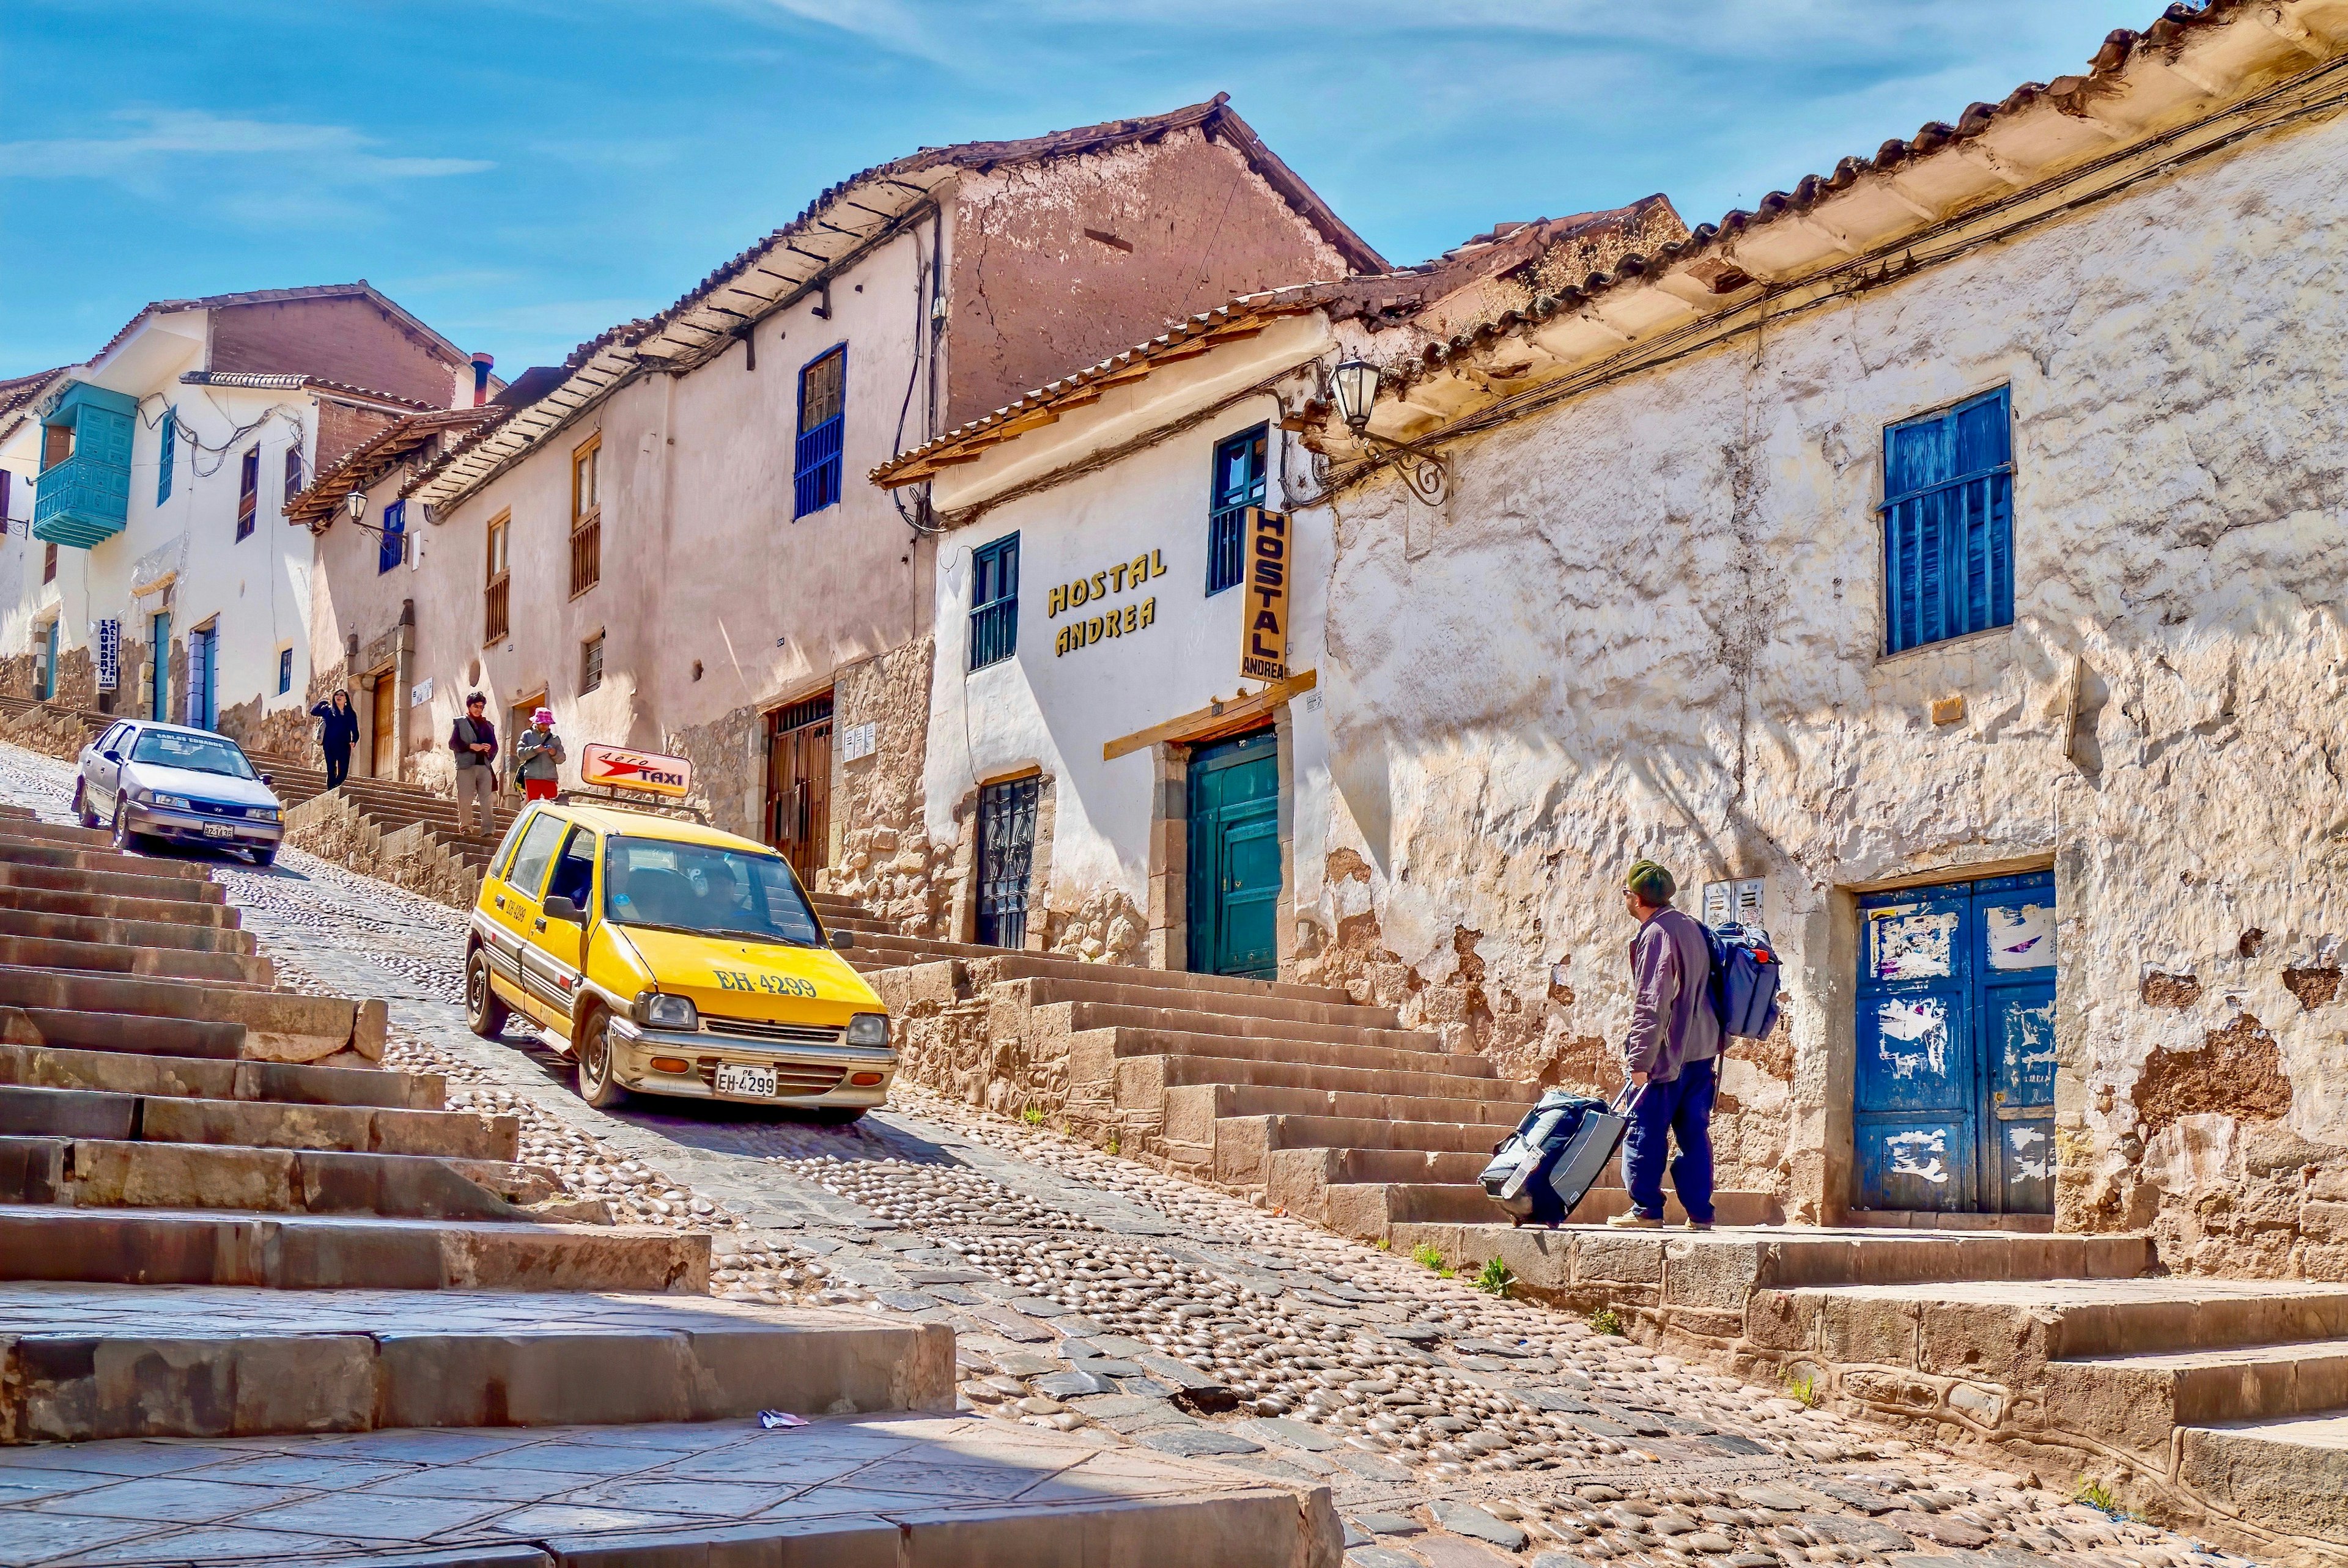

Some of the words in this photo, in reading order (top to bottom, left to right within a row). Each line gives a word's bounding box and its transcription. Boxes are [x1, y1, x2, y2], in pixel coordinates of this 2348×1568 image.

[1048, 548, 1167, 619] HOSTAL
[1252, 510, 1284, 660] HOSTAL
[1055, 597, 1156, 657] ANDREA
[100, 619, 109, 676] LAUNDRY
[1243, 656, 1283, 680] ANDREA
[599, 753, 649, 765] Aero
[638, 769, 682, 786] TAXI
[717, 1074, 774, 1094] EH-4299
